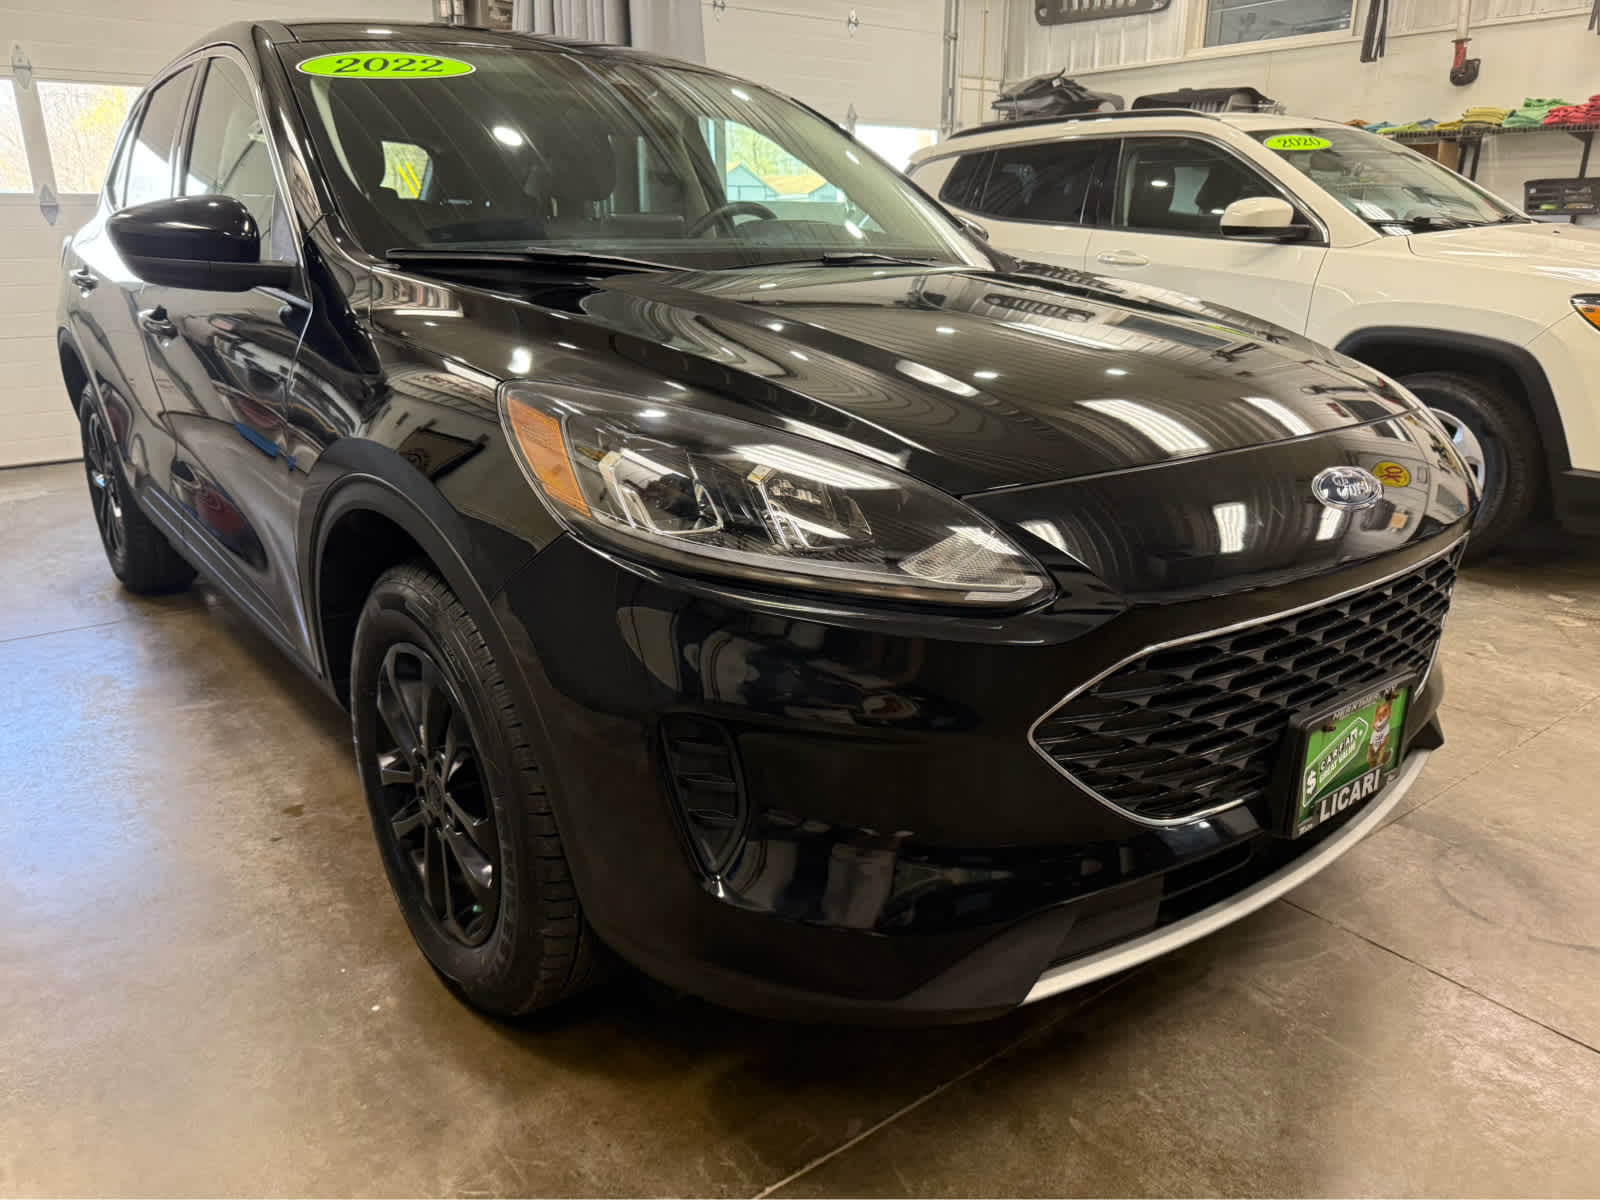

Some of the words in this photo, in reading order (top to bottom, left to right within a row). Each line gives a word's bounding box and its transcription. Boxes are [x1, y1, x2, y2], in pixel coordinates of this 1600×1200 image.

[334, 57, 444, 73] 2022
[1277, 137, 1321, 148] 2020
[1319, 768, 1381, 823] LICARI
